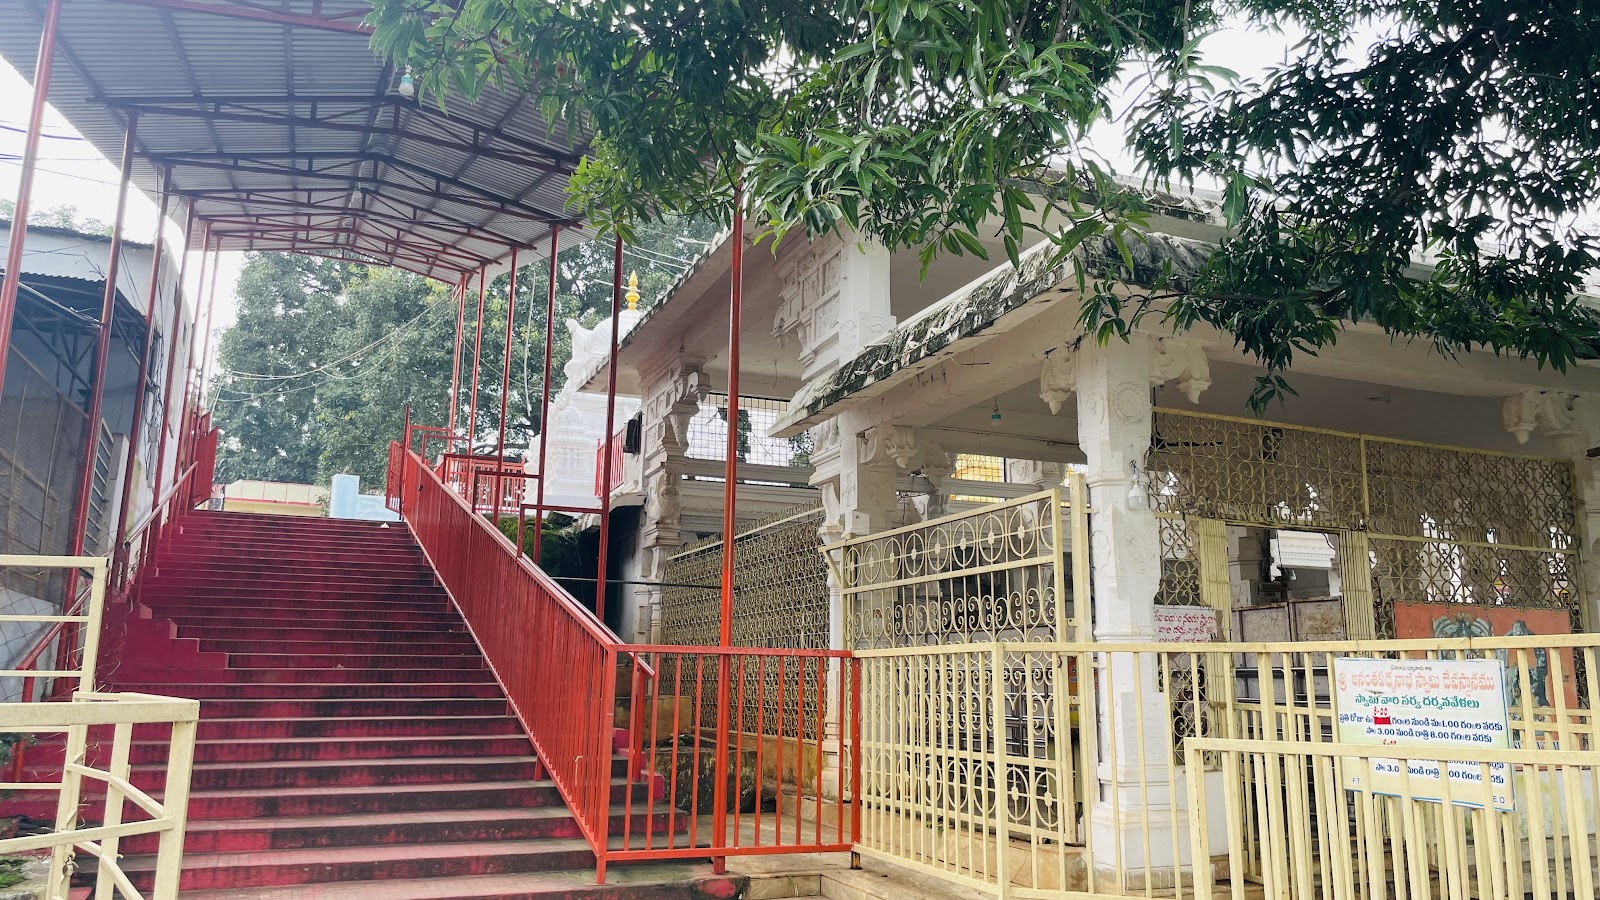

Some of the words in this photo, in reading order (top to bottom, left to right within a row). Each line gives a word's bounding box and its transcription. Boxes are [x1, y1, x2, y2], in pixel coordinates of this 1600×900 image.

[1338, 670, 1347, 692] శ్రీ
[1355, 694, 1378, 706] స్వామి
[1381, 696, 1399, 705] వారి
[1402, 694, 1422, 709] సర్వ
[1339, 713, 1349, 723] ప్రతి
[1350, 712, 1364, 722] రోజు
[1412, 718, 1430, 726] నుండి
[1483, 722, 1503, 731] వరకు
[1396, 728, 1414, 737] నుండి
[1430, 731, 1449, 739] 8.00
[1472, 733, 1492, 742] వరకు
